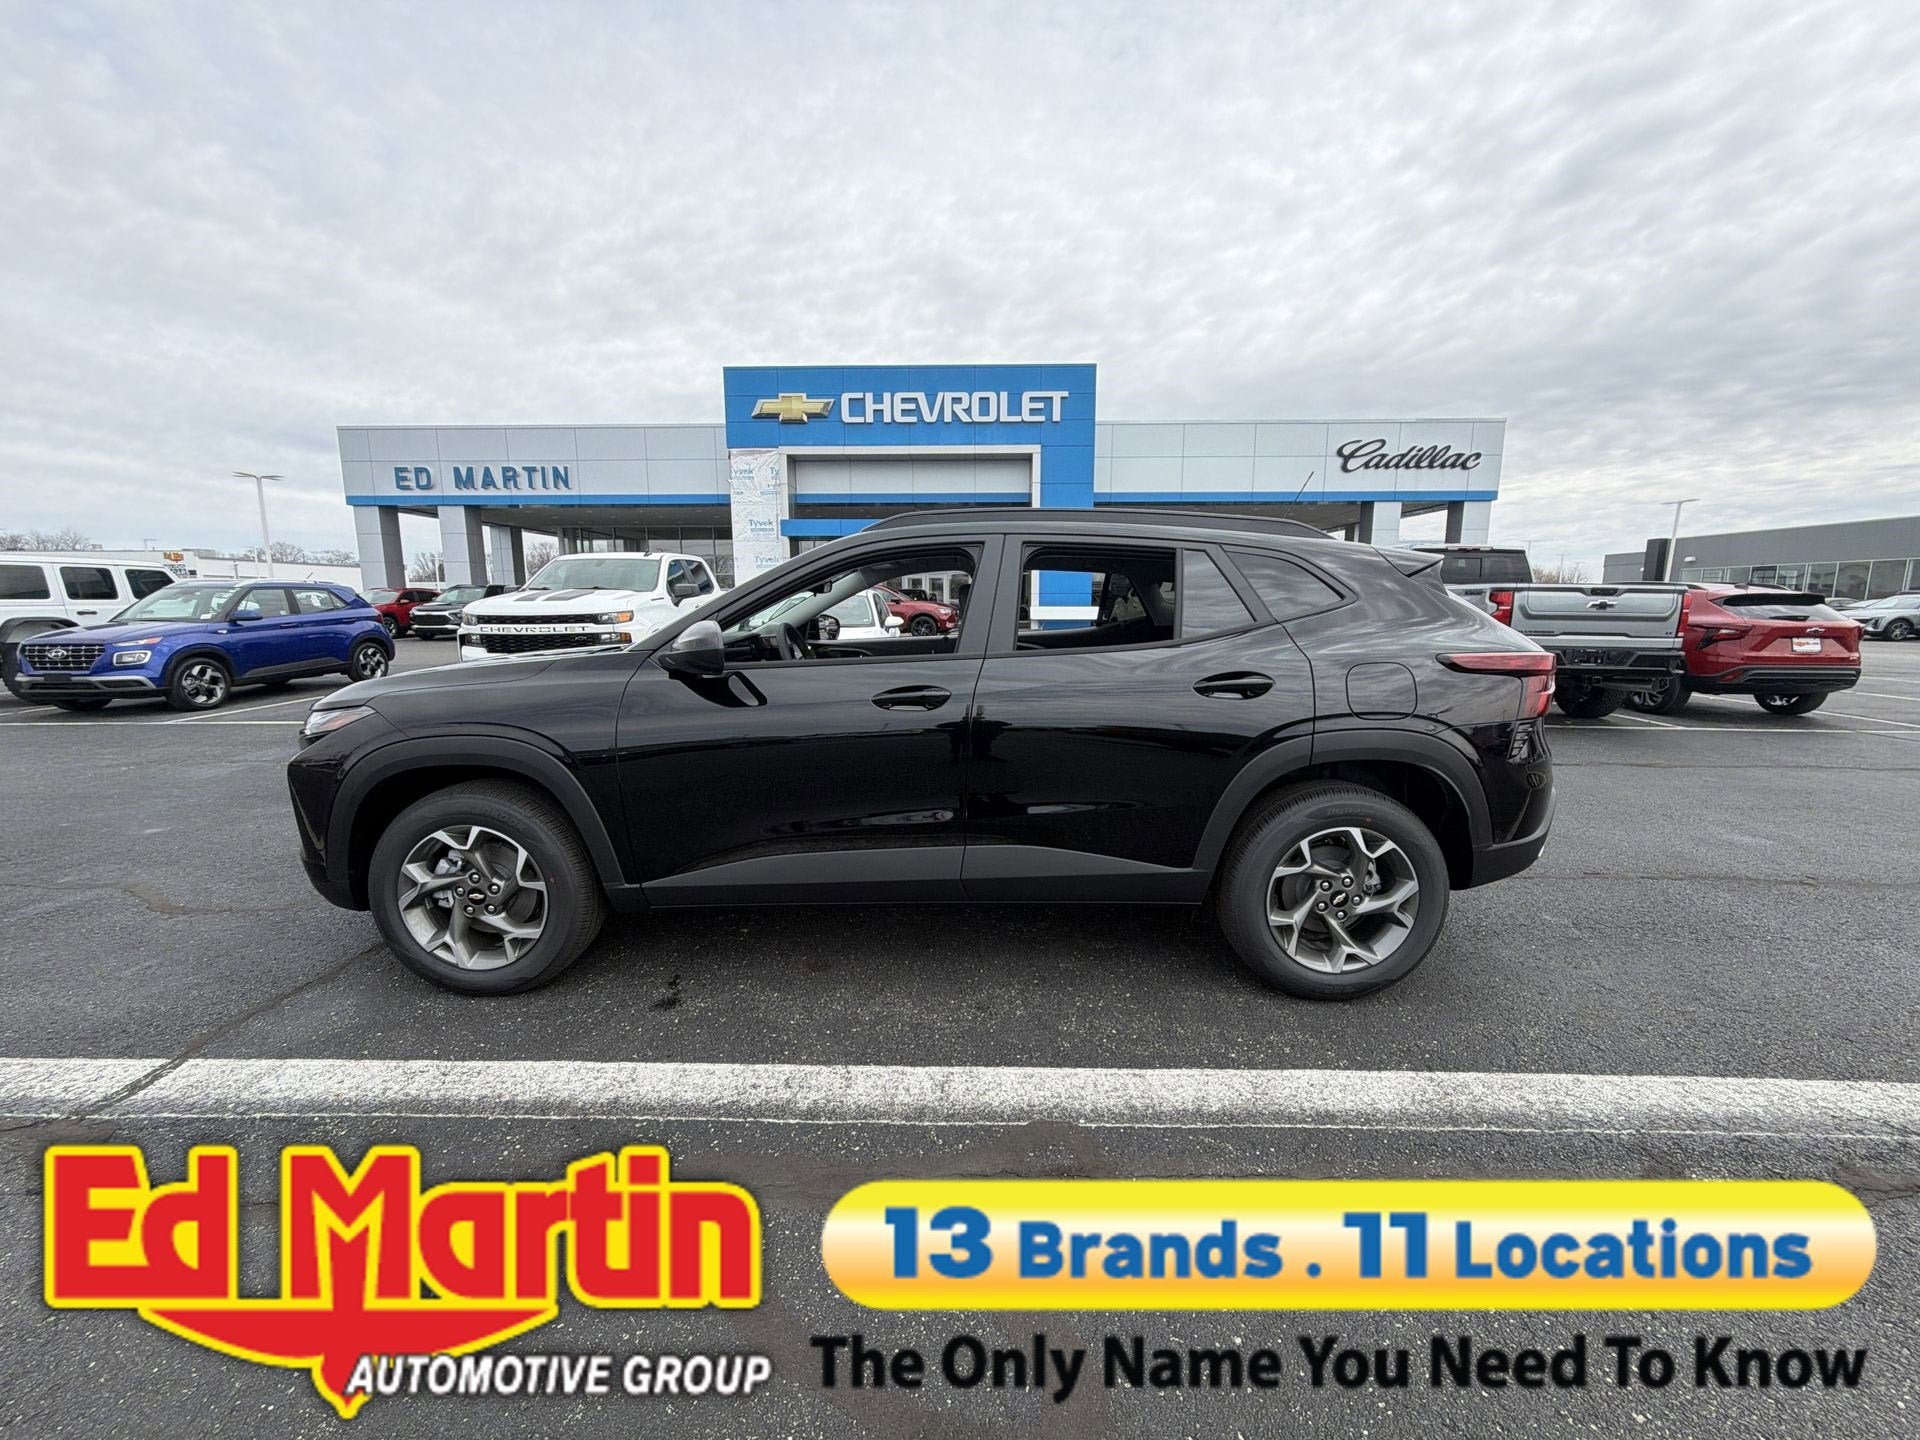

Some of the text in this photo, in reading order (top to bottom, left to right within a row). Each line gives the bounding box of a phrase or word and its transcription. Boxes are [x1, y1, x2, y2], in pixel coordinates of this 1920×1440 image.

[840, 391, 1070, 423] CHEVROLET
[1336, 438, 1483, 474] Cadillac
[393, 465, 573, 491] ED MARTIN
[748, 519, 774, 528] Tyvek
[480, 625, 590, 633] CHEVROLET
